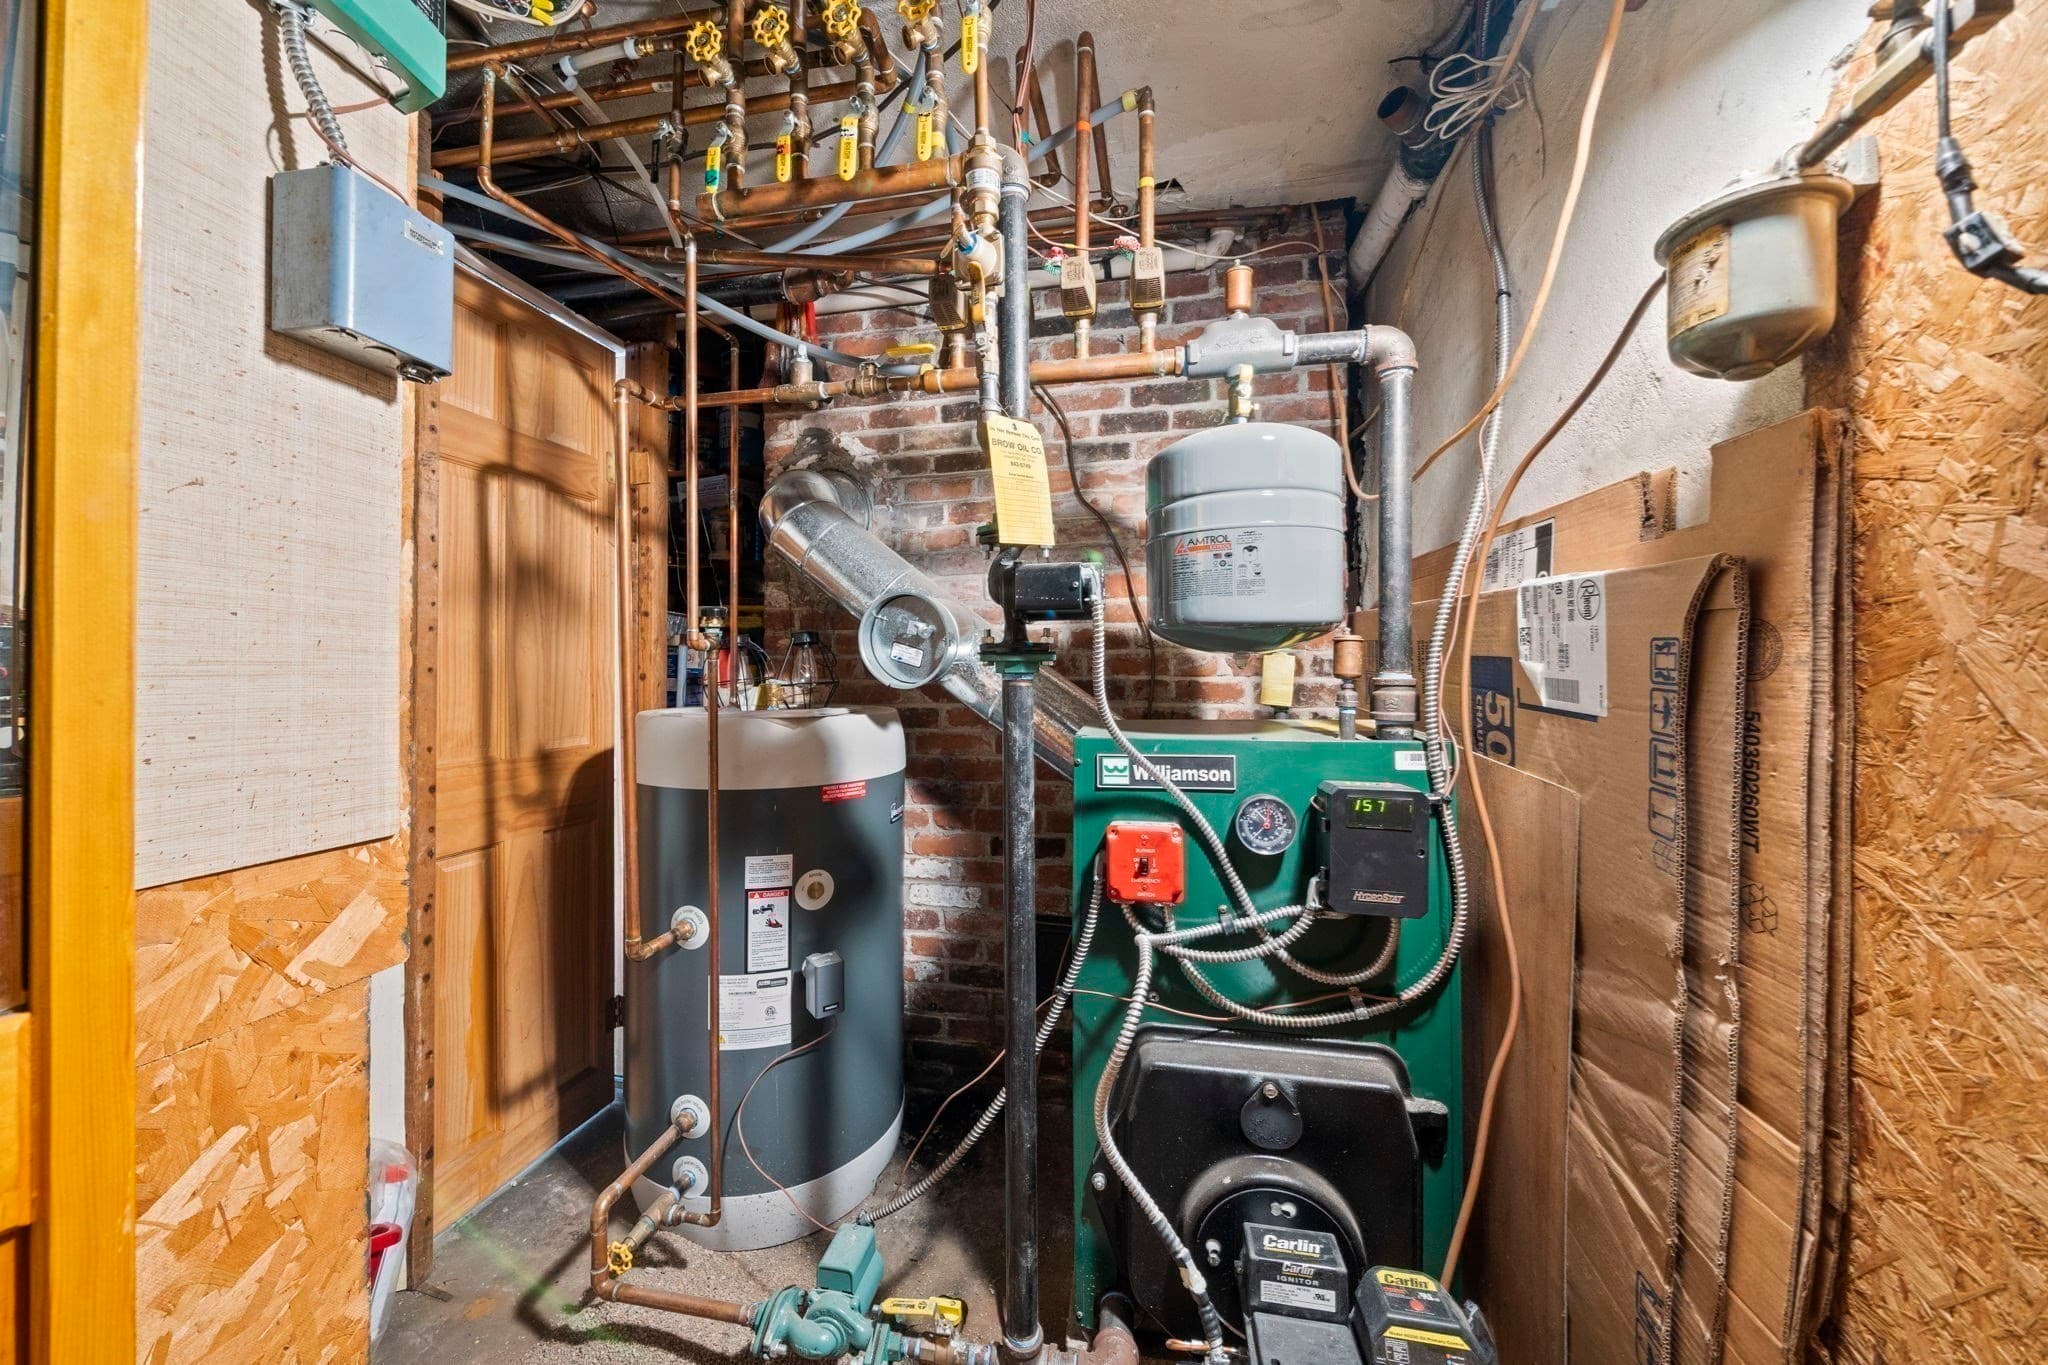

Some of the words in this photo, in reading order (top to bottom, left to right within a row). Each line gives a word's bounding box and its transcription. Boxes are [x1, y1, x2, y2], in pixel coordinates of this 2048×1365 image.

[1017, 443, 1029, 452] OIL
[1187, 535, 1231, 545] AMTROL
[1581, 583, 1600, 618] Rheem
[1485, 690, 1512, 766] 50
[1354, 799, 1386, 813] 157
[762, 890, 785, 898] DANGER
[1263, 1234, 1320, 1254] Carlin
[1282, 1261, 1315, 1275] Carlin
[1276, 1275, 1319, 1287] IGNITOR
[1384, 1273, 1429, 1290] Carlin
